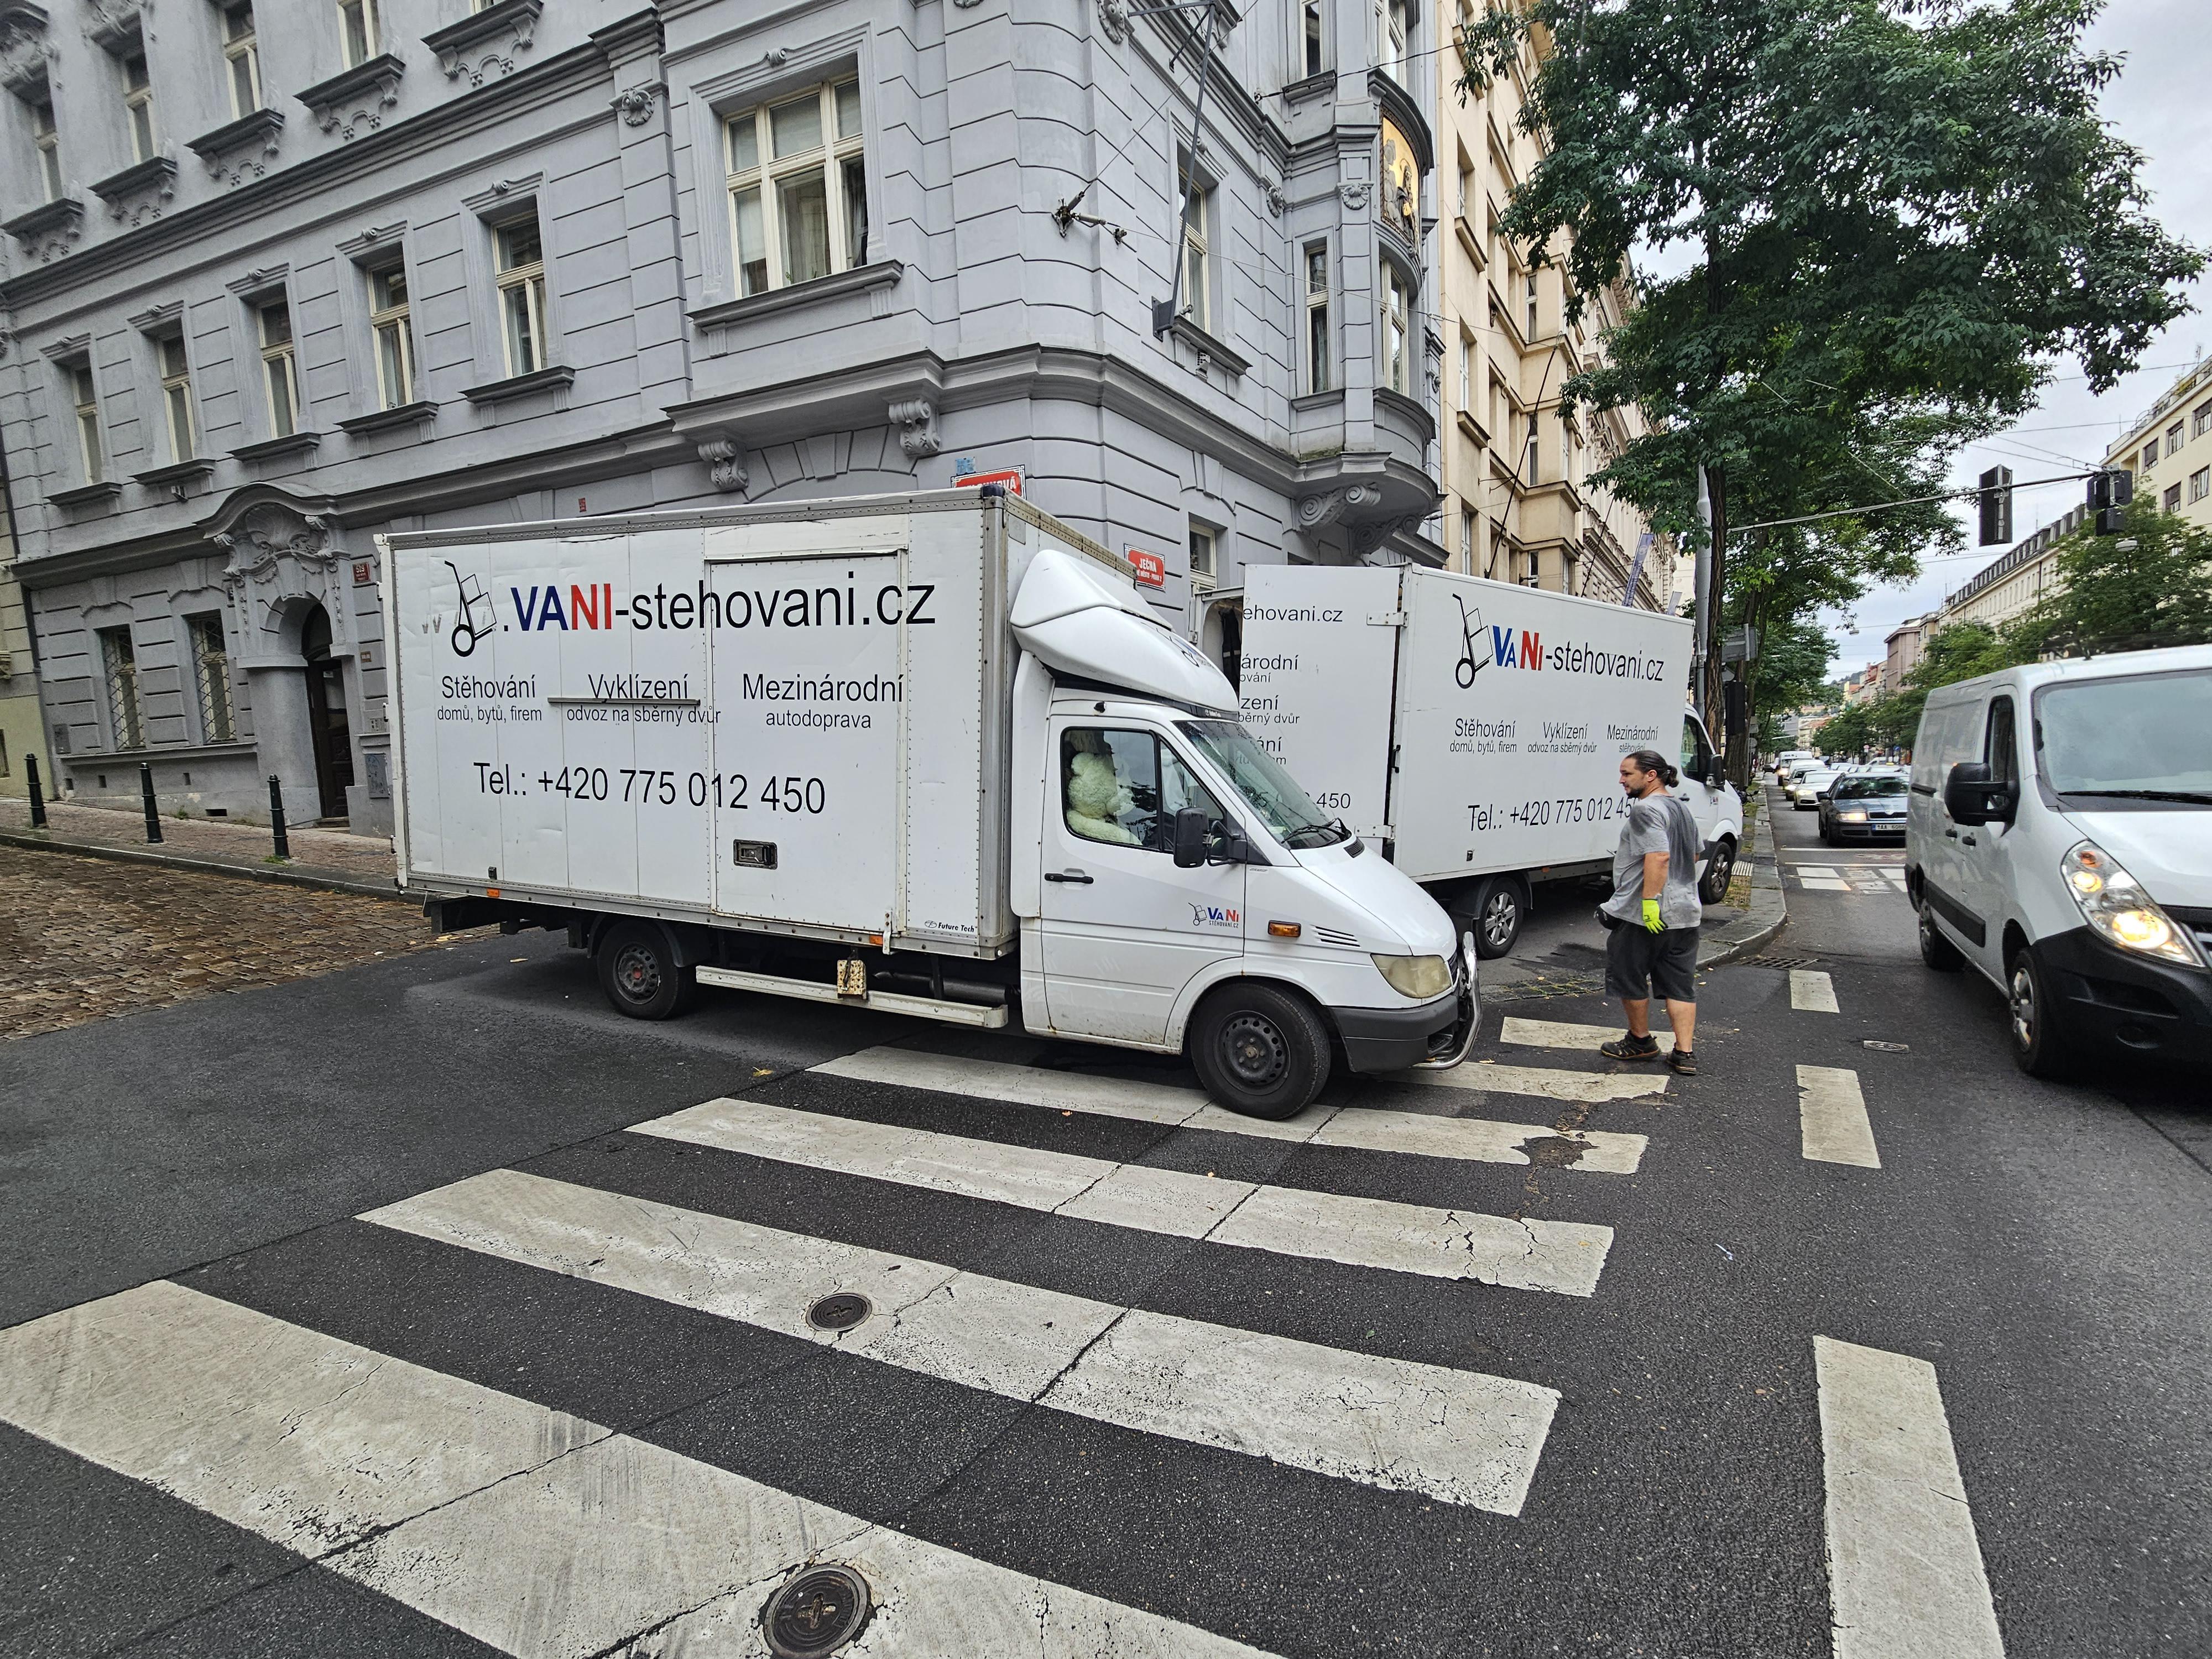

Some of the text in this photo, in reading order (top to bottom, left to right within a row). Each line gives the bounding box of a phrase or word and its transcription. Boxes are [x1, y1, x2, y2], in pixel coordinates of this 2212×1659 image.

[1139, 557, 1156, 572] JEČNÁ
[442, 674, 535, 698] Stěhování
[588, 674, 688, 700] Vyklízení
[743, 674, 904, 702] Mezinárodní
[437, 705, 541, 724] domů, bytů, firem
[567, 705, 721, 727] odvoz na sběrný dvůr
[766, 709, 871, 732] autodoprava
[1274, 713, 1300, 724] dvůr
[1454, 718, 1516, 738] Stěhování
[1543, 721, 1588, 743] Vyklízení
[1607, 724, 1658, 740] Mezinárodní
[1450, 739, 1517, 755] domů, bytů, firem
[1528, 742, 1597, 755] odvoz na sběrný dvůr
[473, 762, 826, 815] Tel.: +420 775 012 450
[1317, 792, 1351, 809] 450
[1468, 804, 1503, 831] Tel.:
[1510, 801, 1550, 826] +420
[1556, 799, 1583, 823] 775
[1587, 797, 1613, 821] 012
[938, 922, 974, 932] Future Tech
